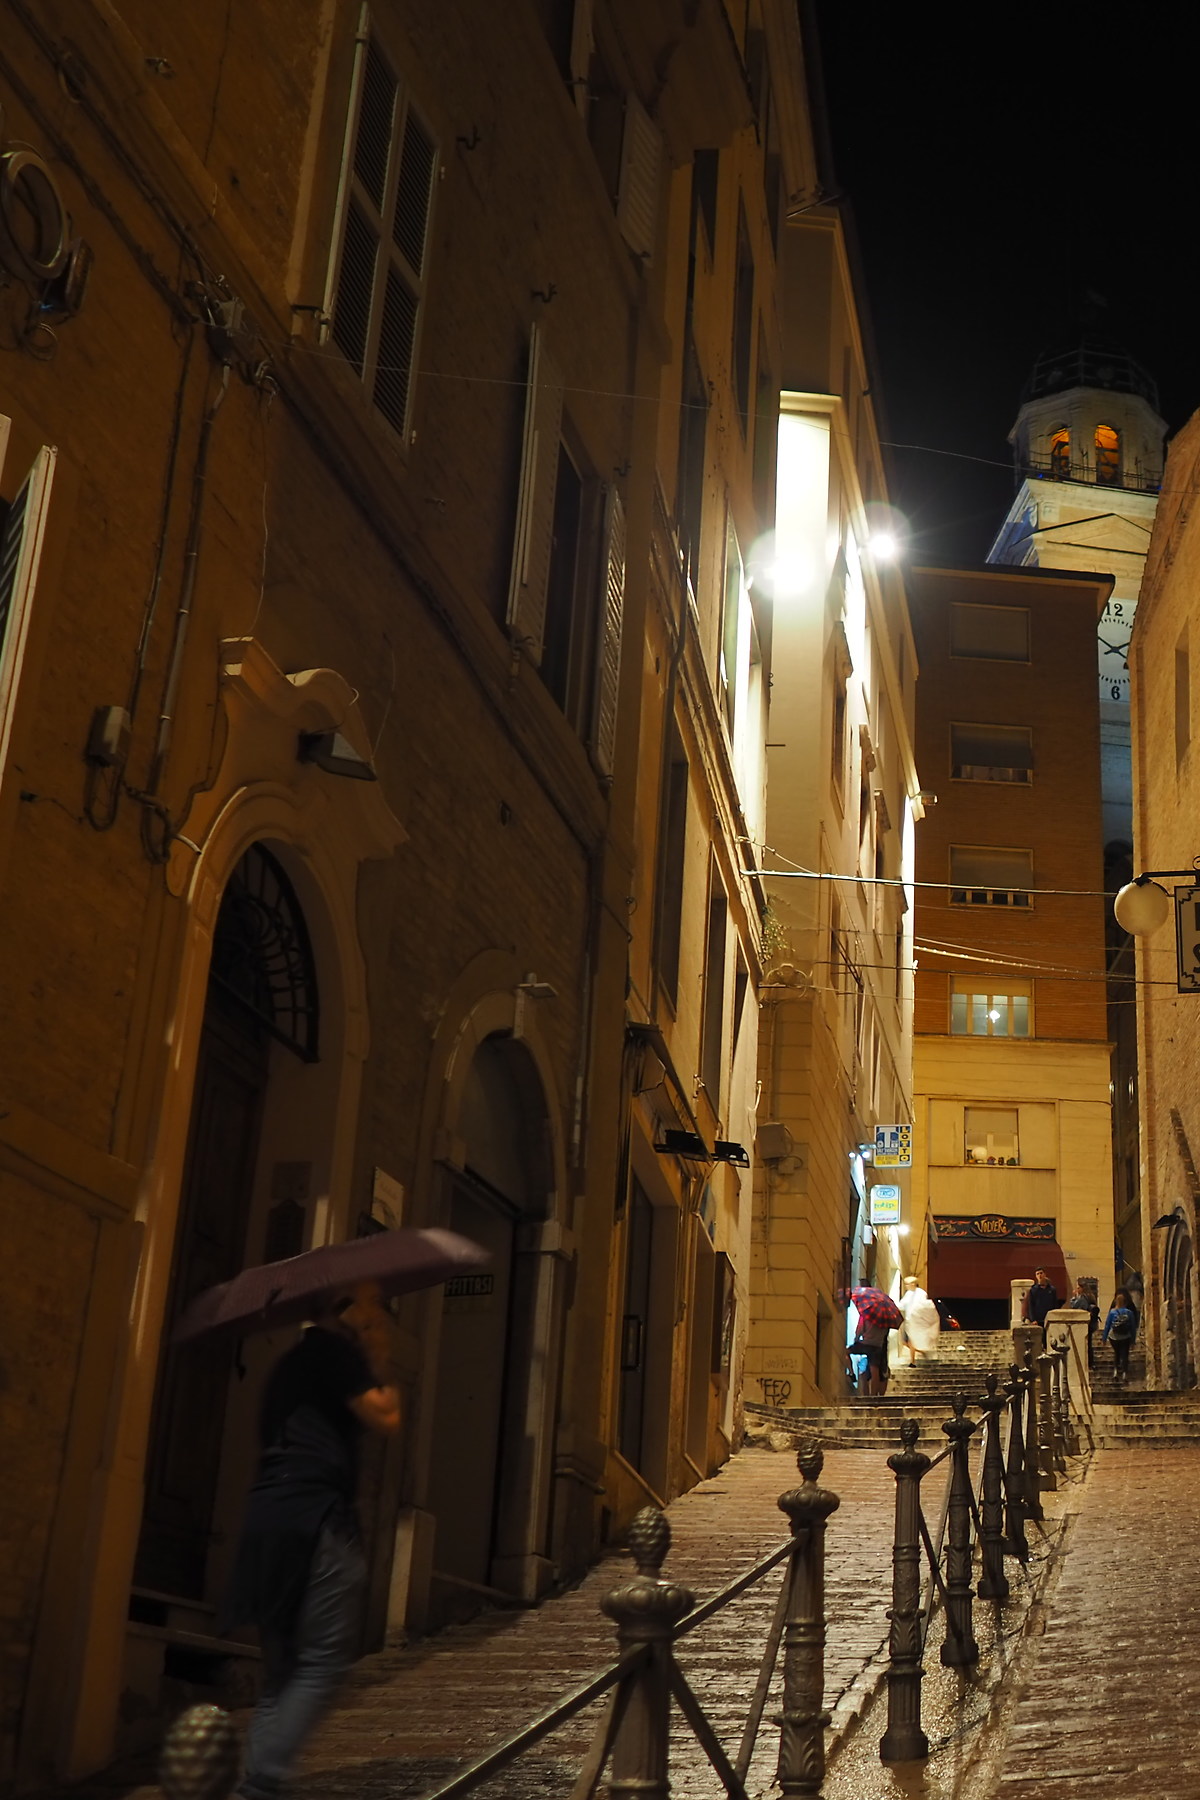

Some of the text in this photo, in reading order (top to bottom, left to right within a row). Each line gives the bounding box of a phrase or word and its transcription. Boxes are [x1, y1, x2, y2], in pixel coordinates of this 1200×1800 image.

[1111, 686, 1120, 700] 6
[899, 1126, 910, 1162] LOTTO
[444, 1277, 493, 1294] FFITTASI
